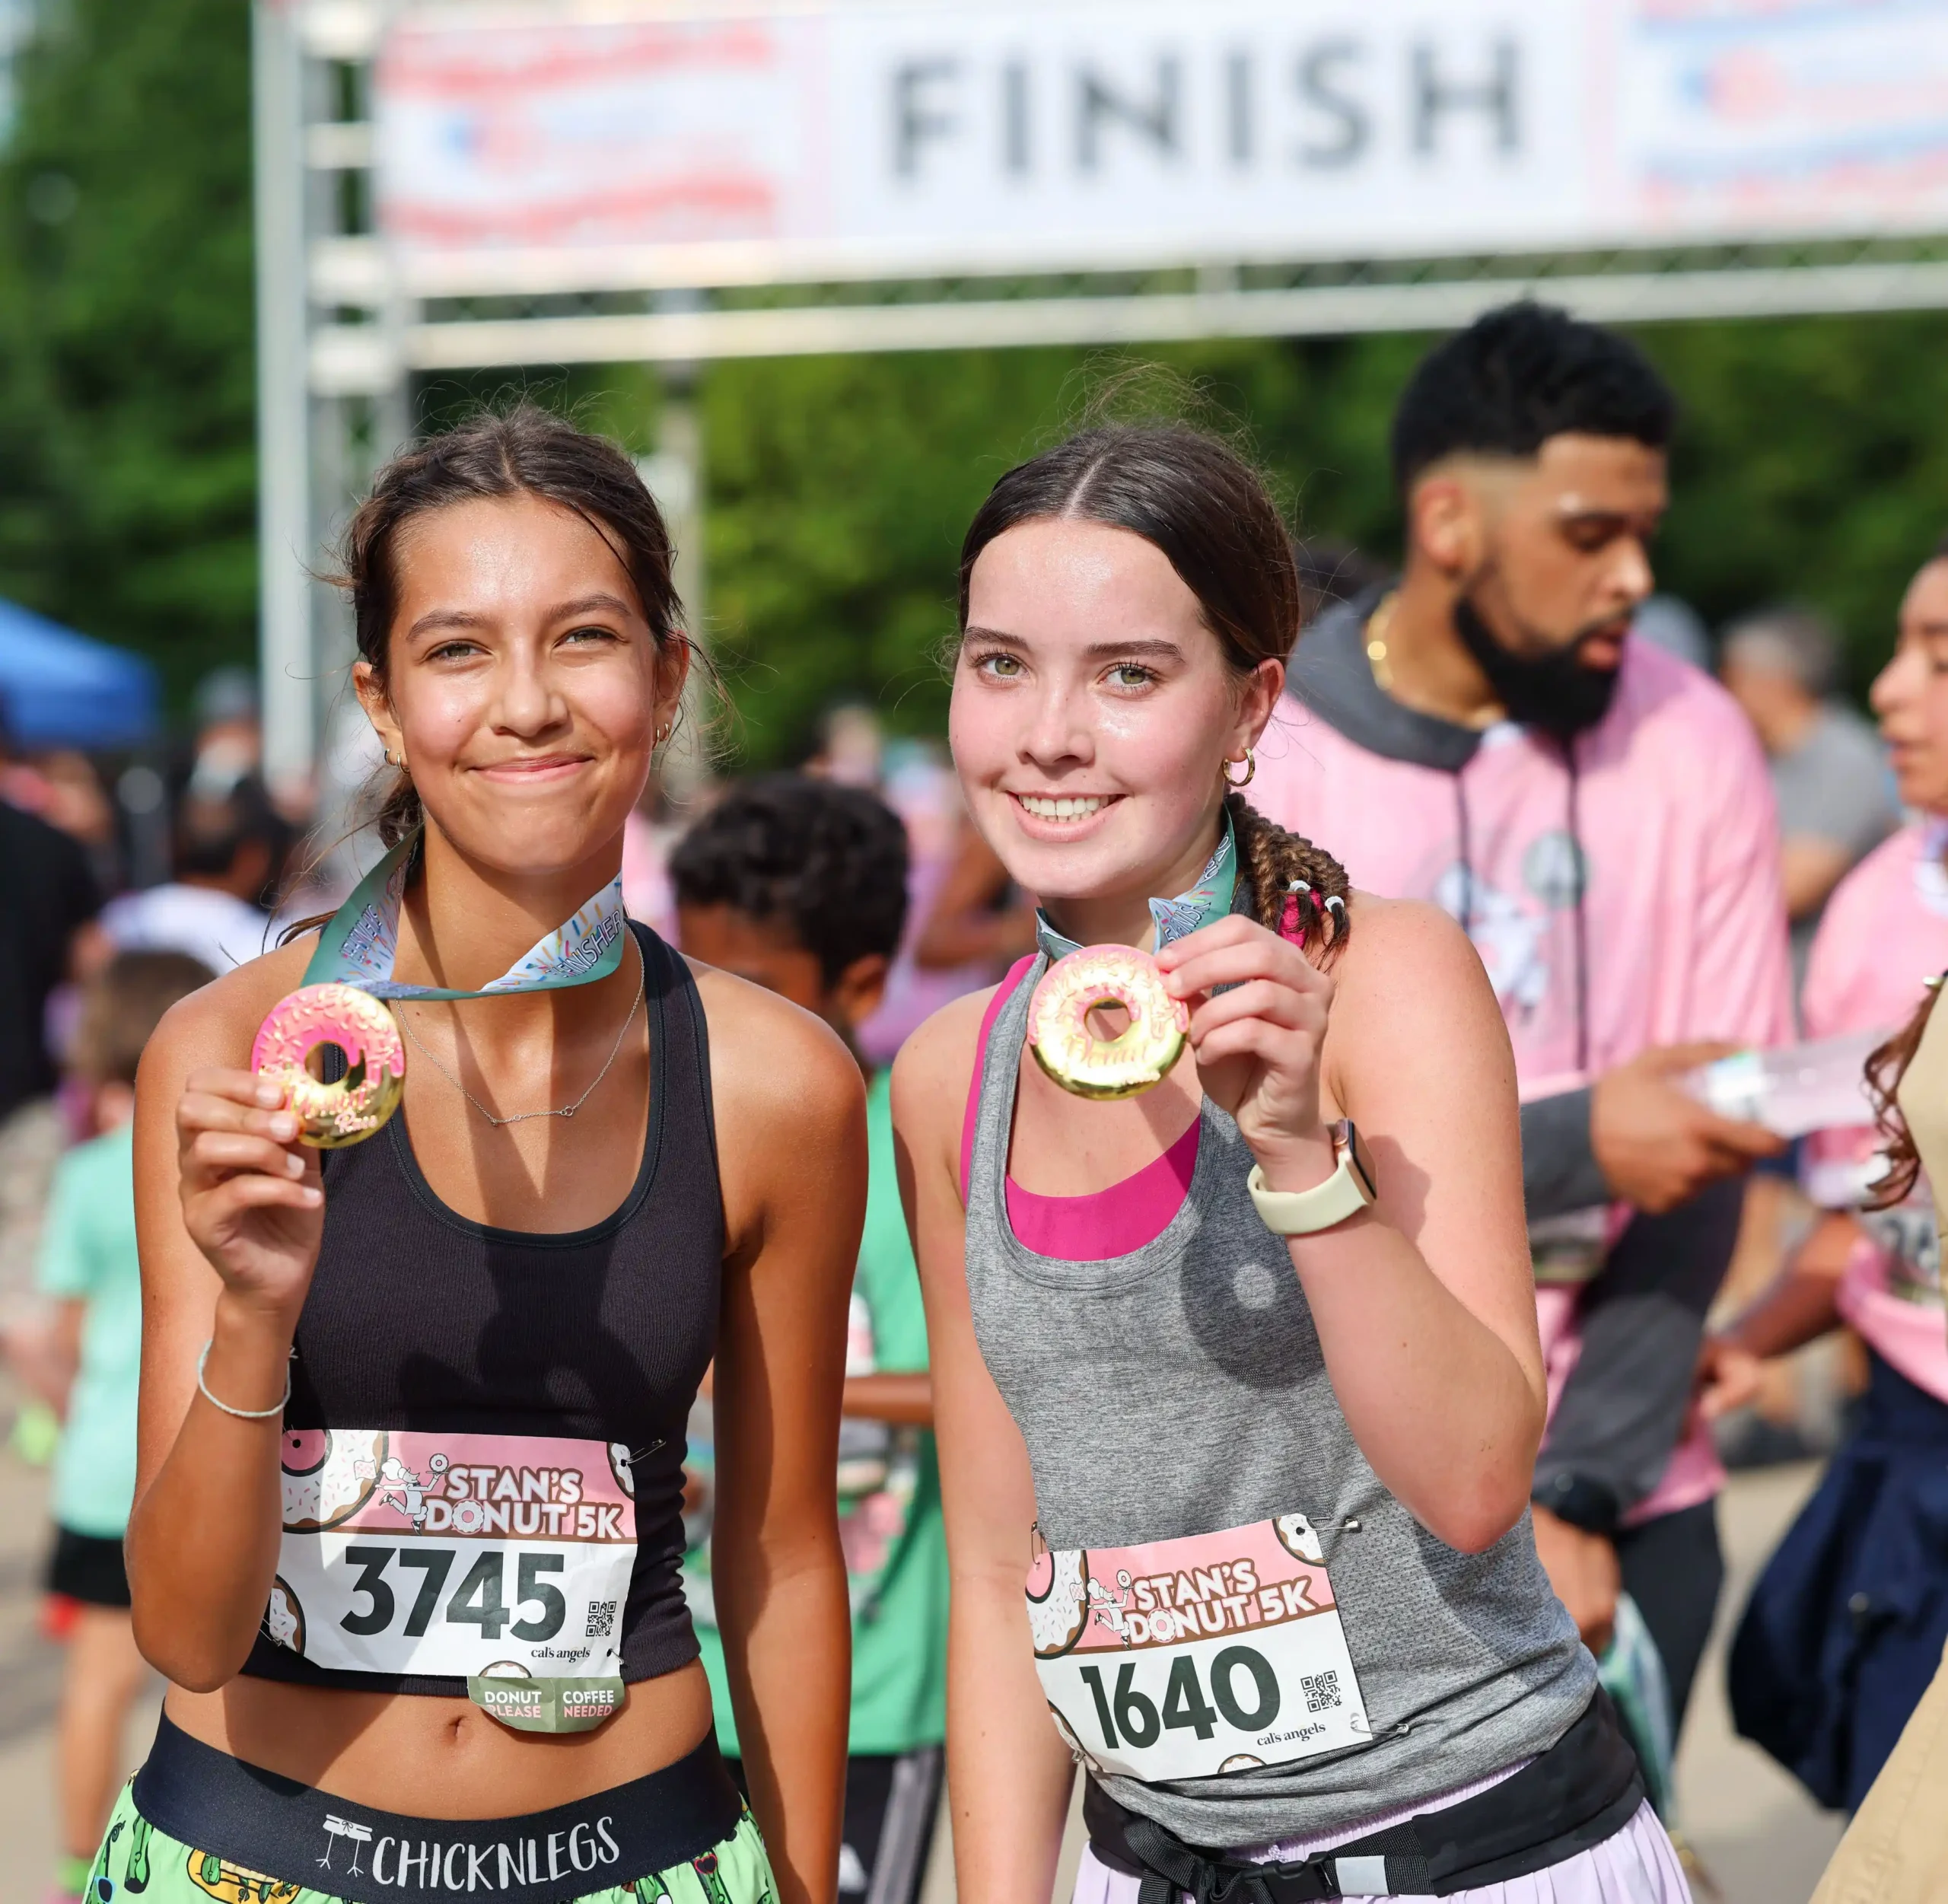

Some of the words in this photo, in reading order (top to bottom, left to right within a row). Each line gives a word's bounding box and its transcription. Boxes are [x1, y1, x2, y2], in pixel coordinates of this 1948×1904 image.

[890, 36, 1525, 183] FINISH
[447, 1467, 581, 1504] STAN'S
[426, 1499, 568, 1534] DONUT
[578, 1507, 622, 1539] 5K
[339, 1546, 566, 1642] 3745
[1136, 1562, 1257, 1610] STAN'S
[1130, 1597, 1250, 1643] DONUT
[1260, 1581, 1315, 1622] 5K
[531, 1647, 555, 1658] cal's
[556, 1647, 590, 1663] angels
[484, 1691, 542, 1704] DONUT
[563, 1690, 614, 1704] COFFEE
[564, 1705, 613, 1718] NEEDED
[1079, 1645, 1281, 1749] 1640
[1257, 1733, 1281, 1746] cal's
[1284, 1723, 1326, 1741] angels
[372, 1816, 620, 1892] CHICKNLEGS
